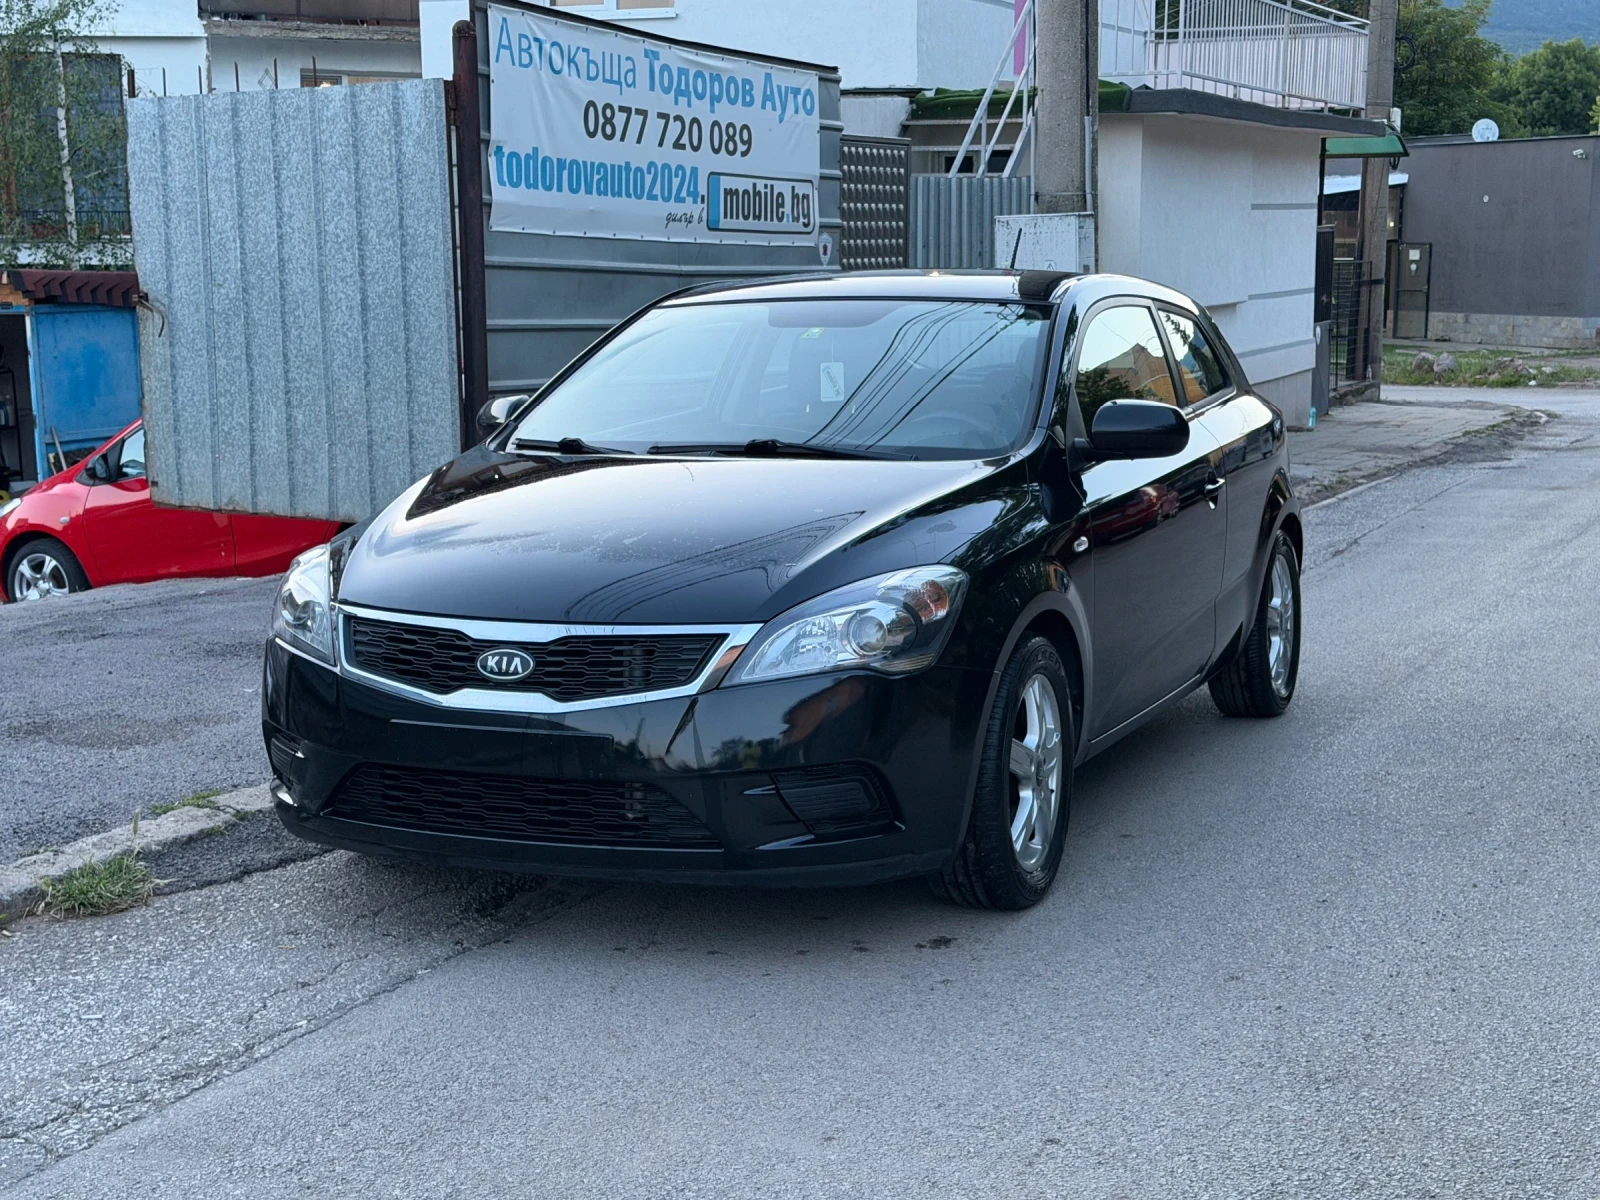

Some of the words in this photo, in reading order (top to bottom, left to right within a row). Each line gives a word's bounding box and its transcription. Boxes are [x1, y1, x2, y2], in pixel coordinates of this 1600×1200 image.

[495, 16, 637, 96] Автокъща
[643, 47, 756, 114] Тодоров
[760, 71, 815, 125] Ауто
[583, 99, 649, 145] 0877
[656, 111, 703, 153] 720
[709, 119, 753, 158] 089
[723, 182, 811, 228] mobile.bg
[486, 655, 522, 673] KIA
